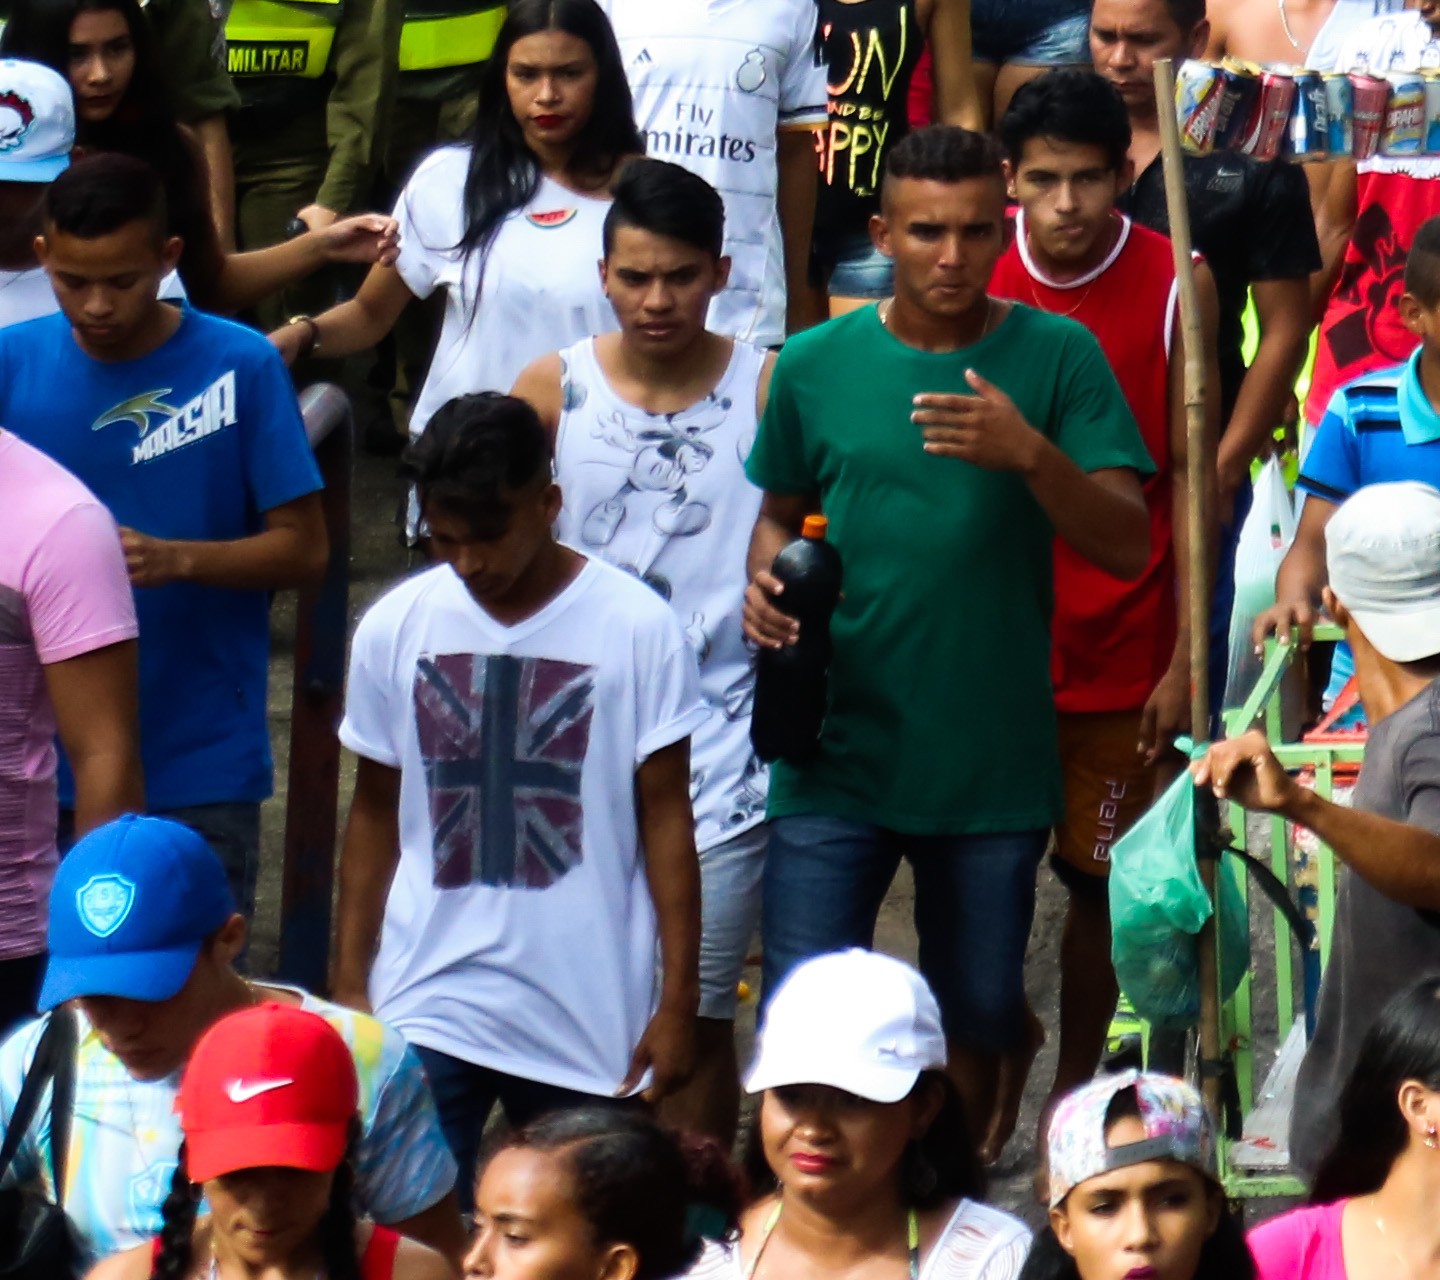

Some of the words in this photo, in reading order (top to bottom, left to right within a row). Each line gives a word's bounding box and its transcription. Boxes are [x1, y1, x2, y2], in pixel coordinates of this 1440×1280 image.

[227, 43, 306, 74] MILITAR
[827, 7, 907, 100] UN
[676, 102, 714, 129] Fly
[643, 129, 757, 165] mirates
[131, 369, 238, 466] MARESIA
[1093, 780, 1126, 863] Pena
